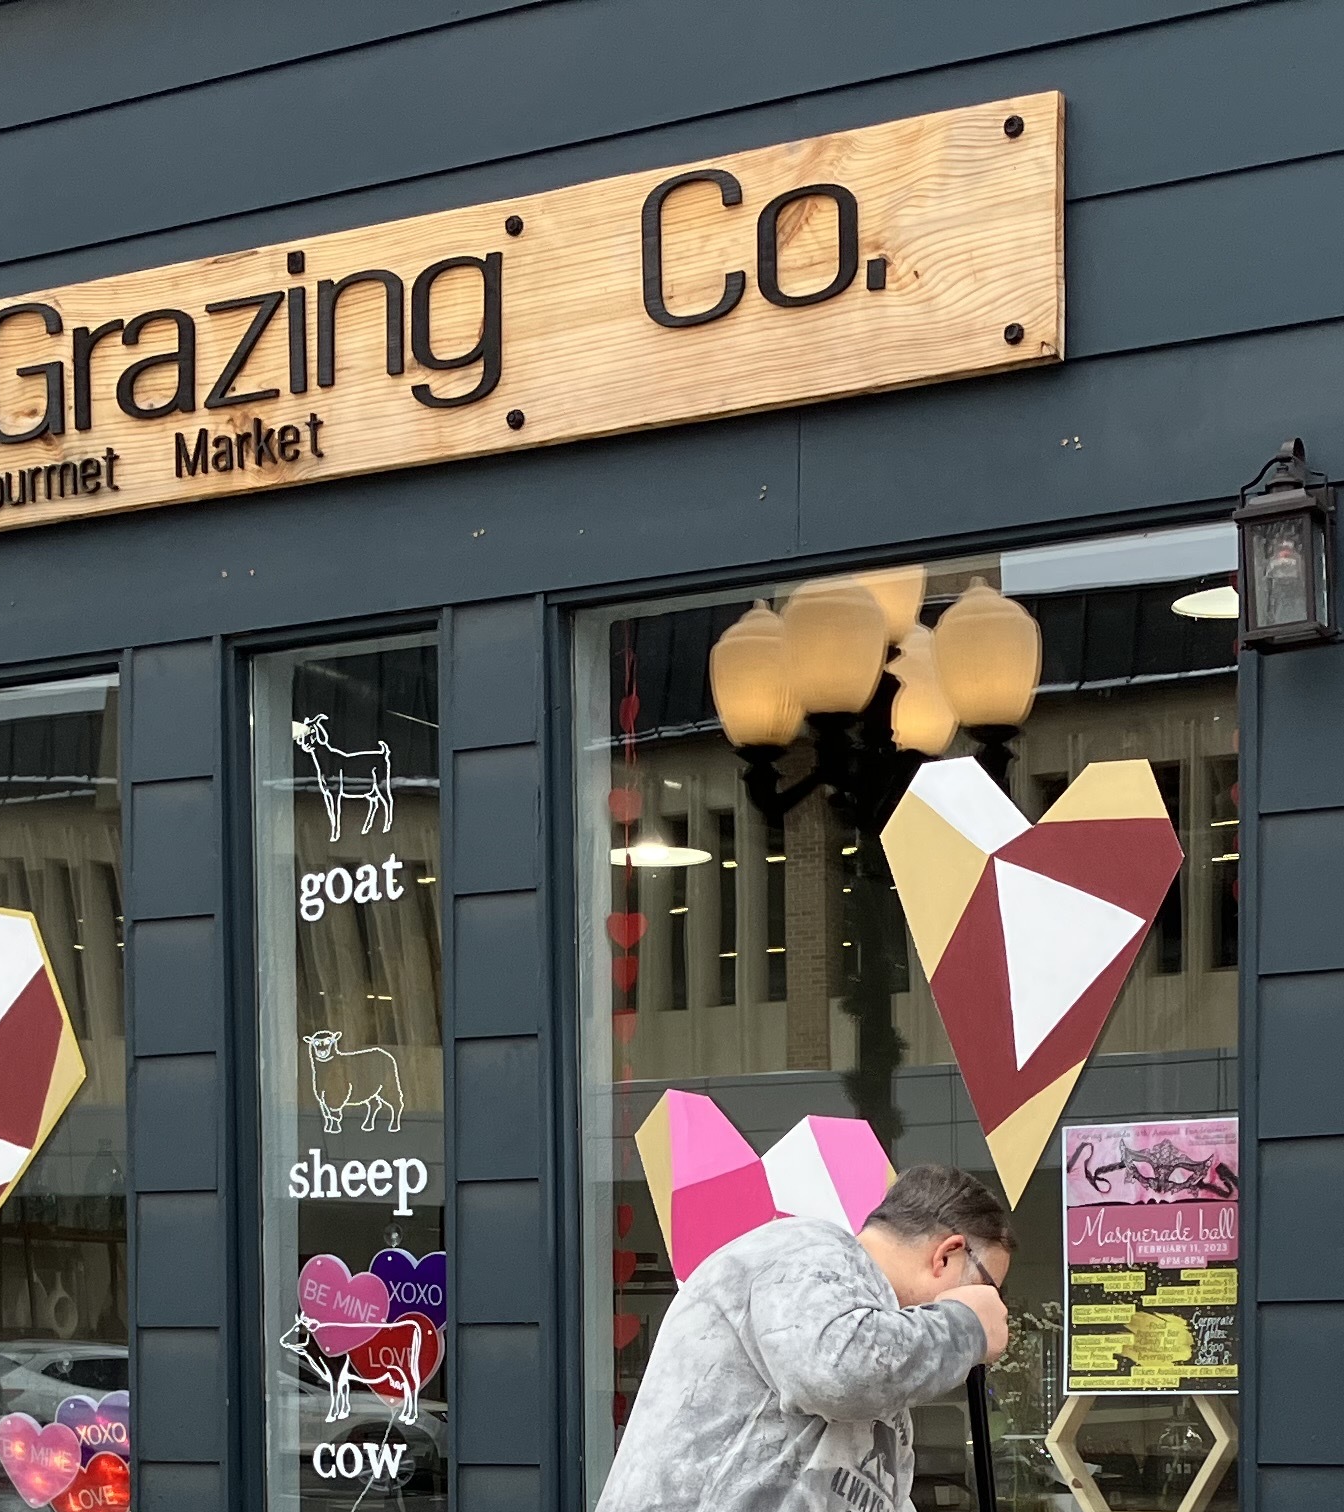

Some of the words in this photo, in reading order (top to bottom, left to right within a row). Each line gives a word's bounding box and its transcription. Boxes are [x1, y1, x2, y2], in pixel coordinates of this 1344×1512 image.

[641, 168, 888, 329] Co.
[174, 412, 325, 479] Market
[299, 853, 405, 922] goat
[288, 1148, 429, 1217] sheep
[1072, 1207, 1194, 1269] Masquerade
[1198, 1206, 1235, 1241] ball
[1138, 1243, 1187, 1254] FEBRUARY
[1204, 1242, 1228, 1253] 2023
[1159, 1256, 1205, 1266] 6PM-8PM
[303, 1278, 331, 1307] BE
[332, 1290, 380, 1323] MINE
[389, 1280, 443, 1306] XOXO
[1157, 1367, 1188, 1376] Available
[76, 1421, 128, 1446] XOXO
[312, 1442, 408, 1479] cow
[68, 1484, 119, 1512] LOVE
